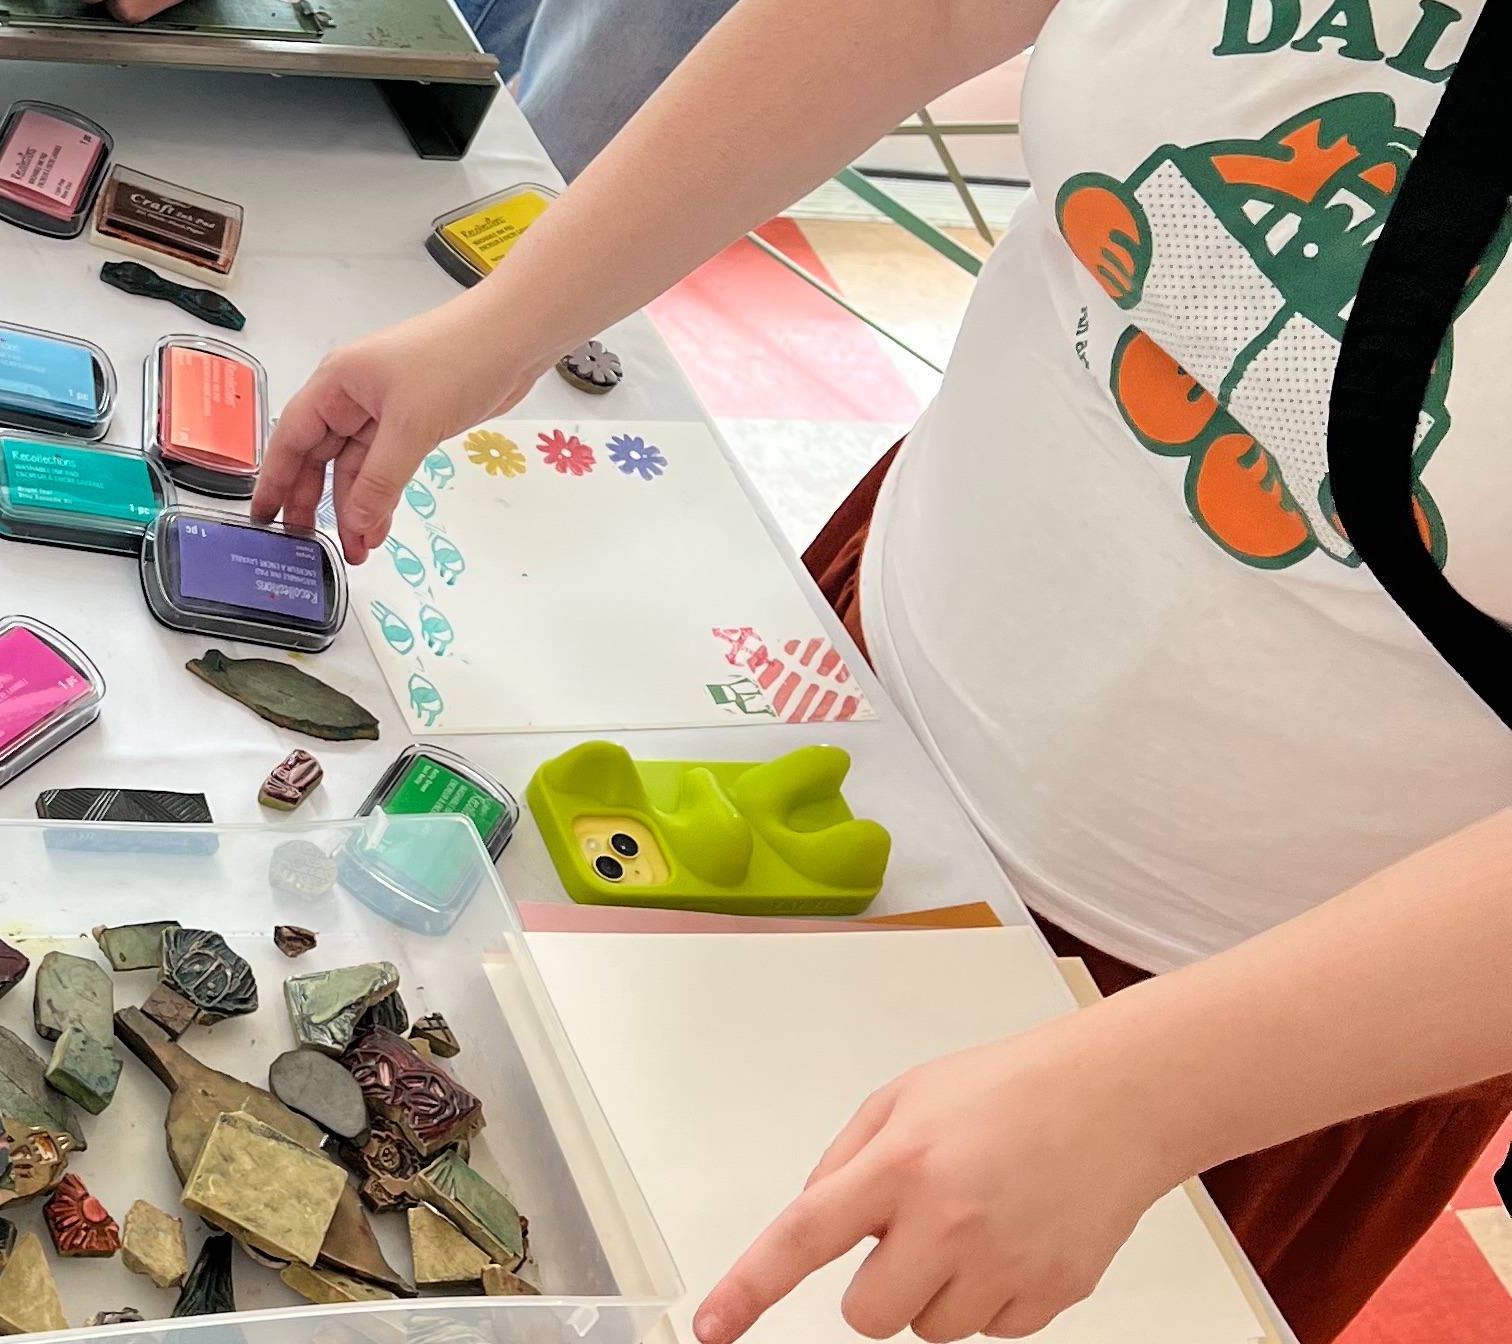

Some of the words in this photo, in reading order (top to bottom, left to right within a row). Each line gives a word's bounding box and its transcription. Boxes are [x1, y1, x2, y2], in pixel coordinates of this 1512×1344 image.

[130, 192, 175, 214] Craft
[176, 211, 194, 222] Ink
[194, 217, 216, 230] Pad
[67, 389, 74, 397] 1
[76, 392, 89, 401] pc
[12, 450, 76, 468] Recollections
[129, 504, 135, 512] 1
[137, 506, 150, 516] pc
[185, 524, 198, 534] pc
[200, 528, 207, 537] 1
[255, 579, 318, 604] Recollections
[57, 679, 67, 691] 1
[66, 675, 80, 690] pc
